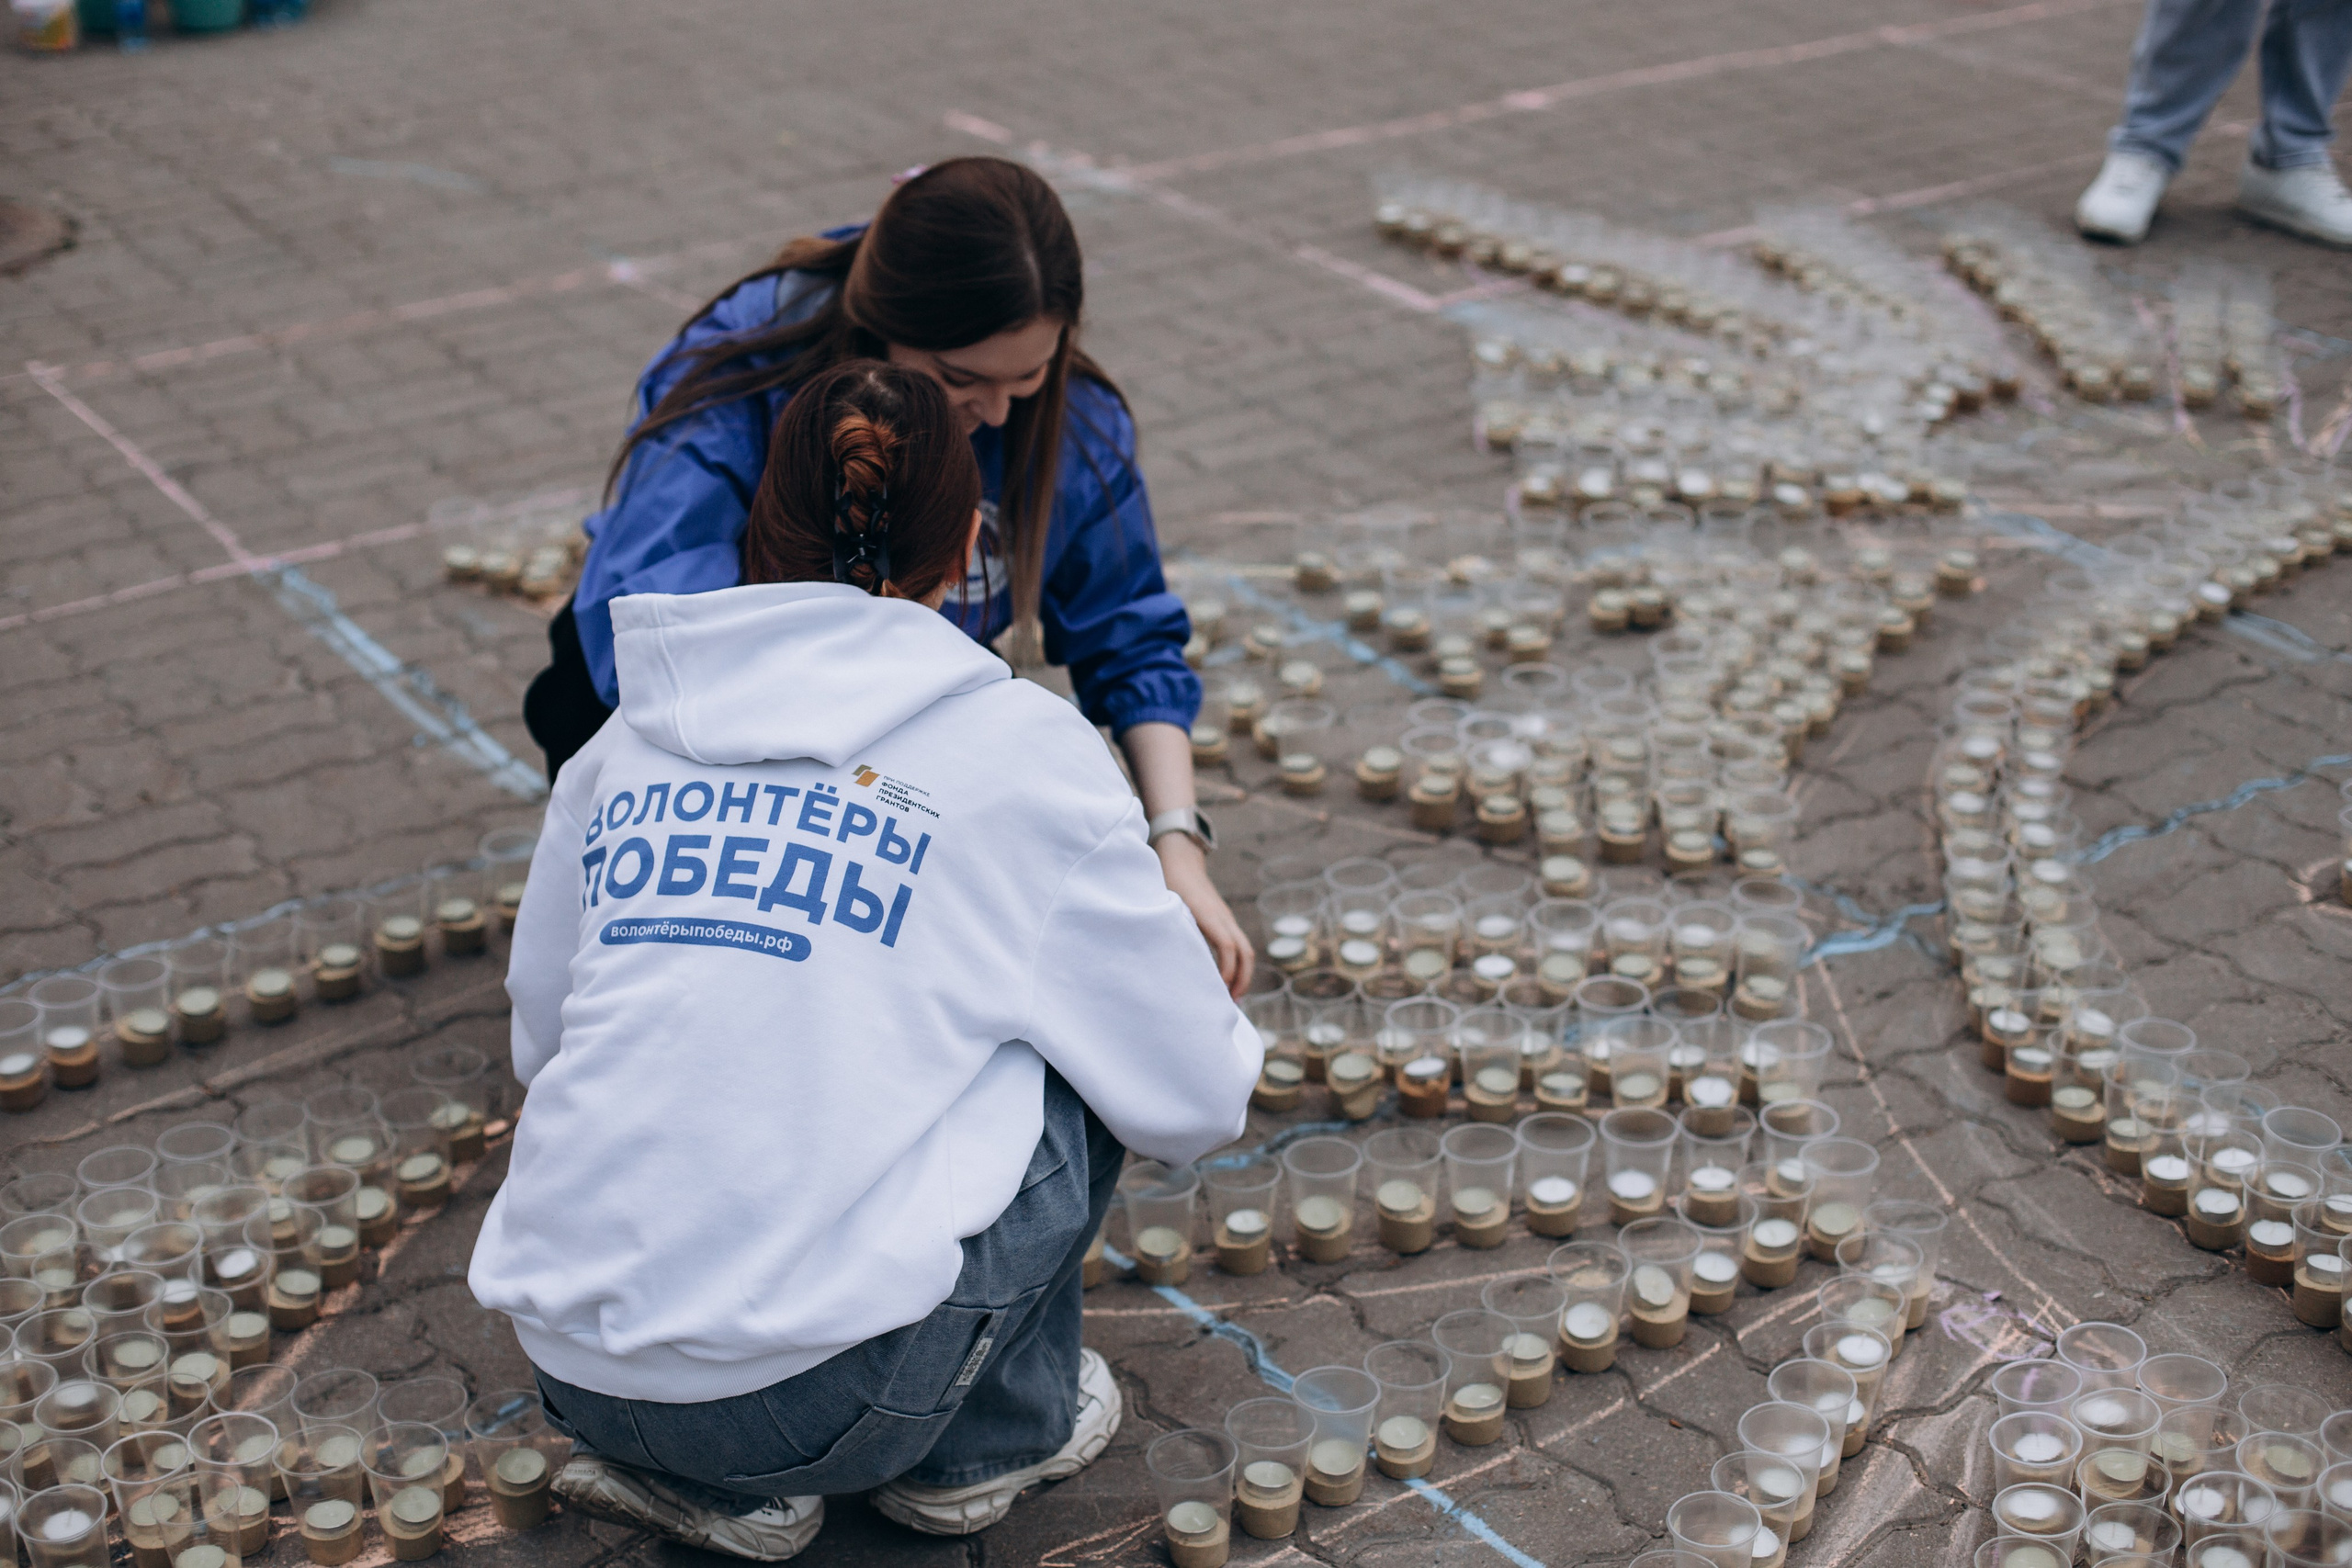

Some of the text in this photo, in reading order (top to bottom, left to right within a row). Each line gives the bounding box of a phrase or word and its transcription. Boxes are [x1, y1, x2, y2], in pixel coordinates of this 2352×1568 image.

[881, 782, 909, 796] ФОНДА
[883, 775, 931, 797] ПРИ ПОДДЕРЖКЕ
[876, 795, 910, 813] ГРАНТОВ
[878, 788, 941, 818] ПРЕЗИДЕНТСКИХ
[585, 782, 931, 875] ВОЛОНТЁРЫ
[582, 834, 913, 948] ПОБЕДЫ
[610, 919, 793, 954] волонтёрыпобеды.рф
